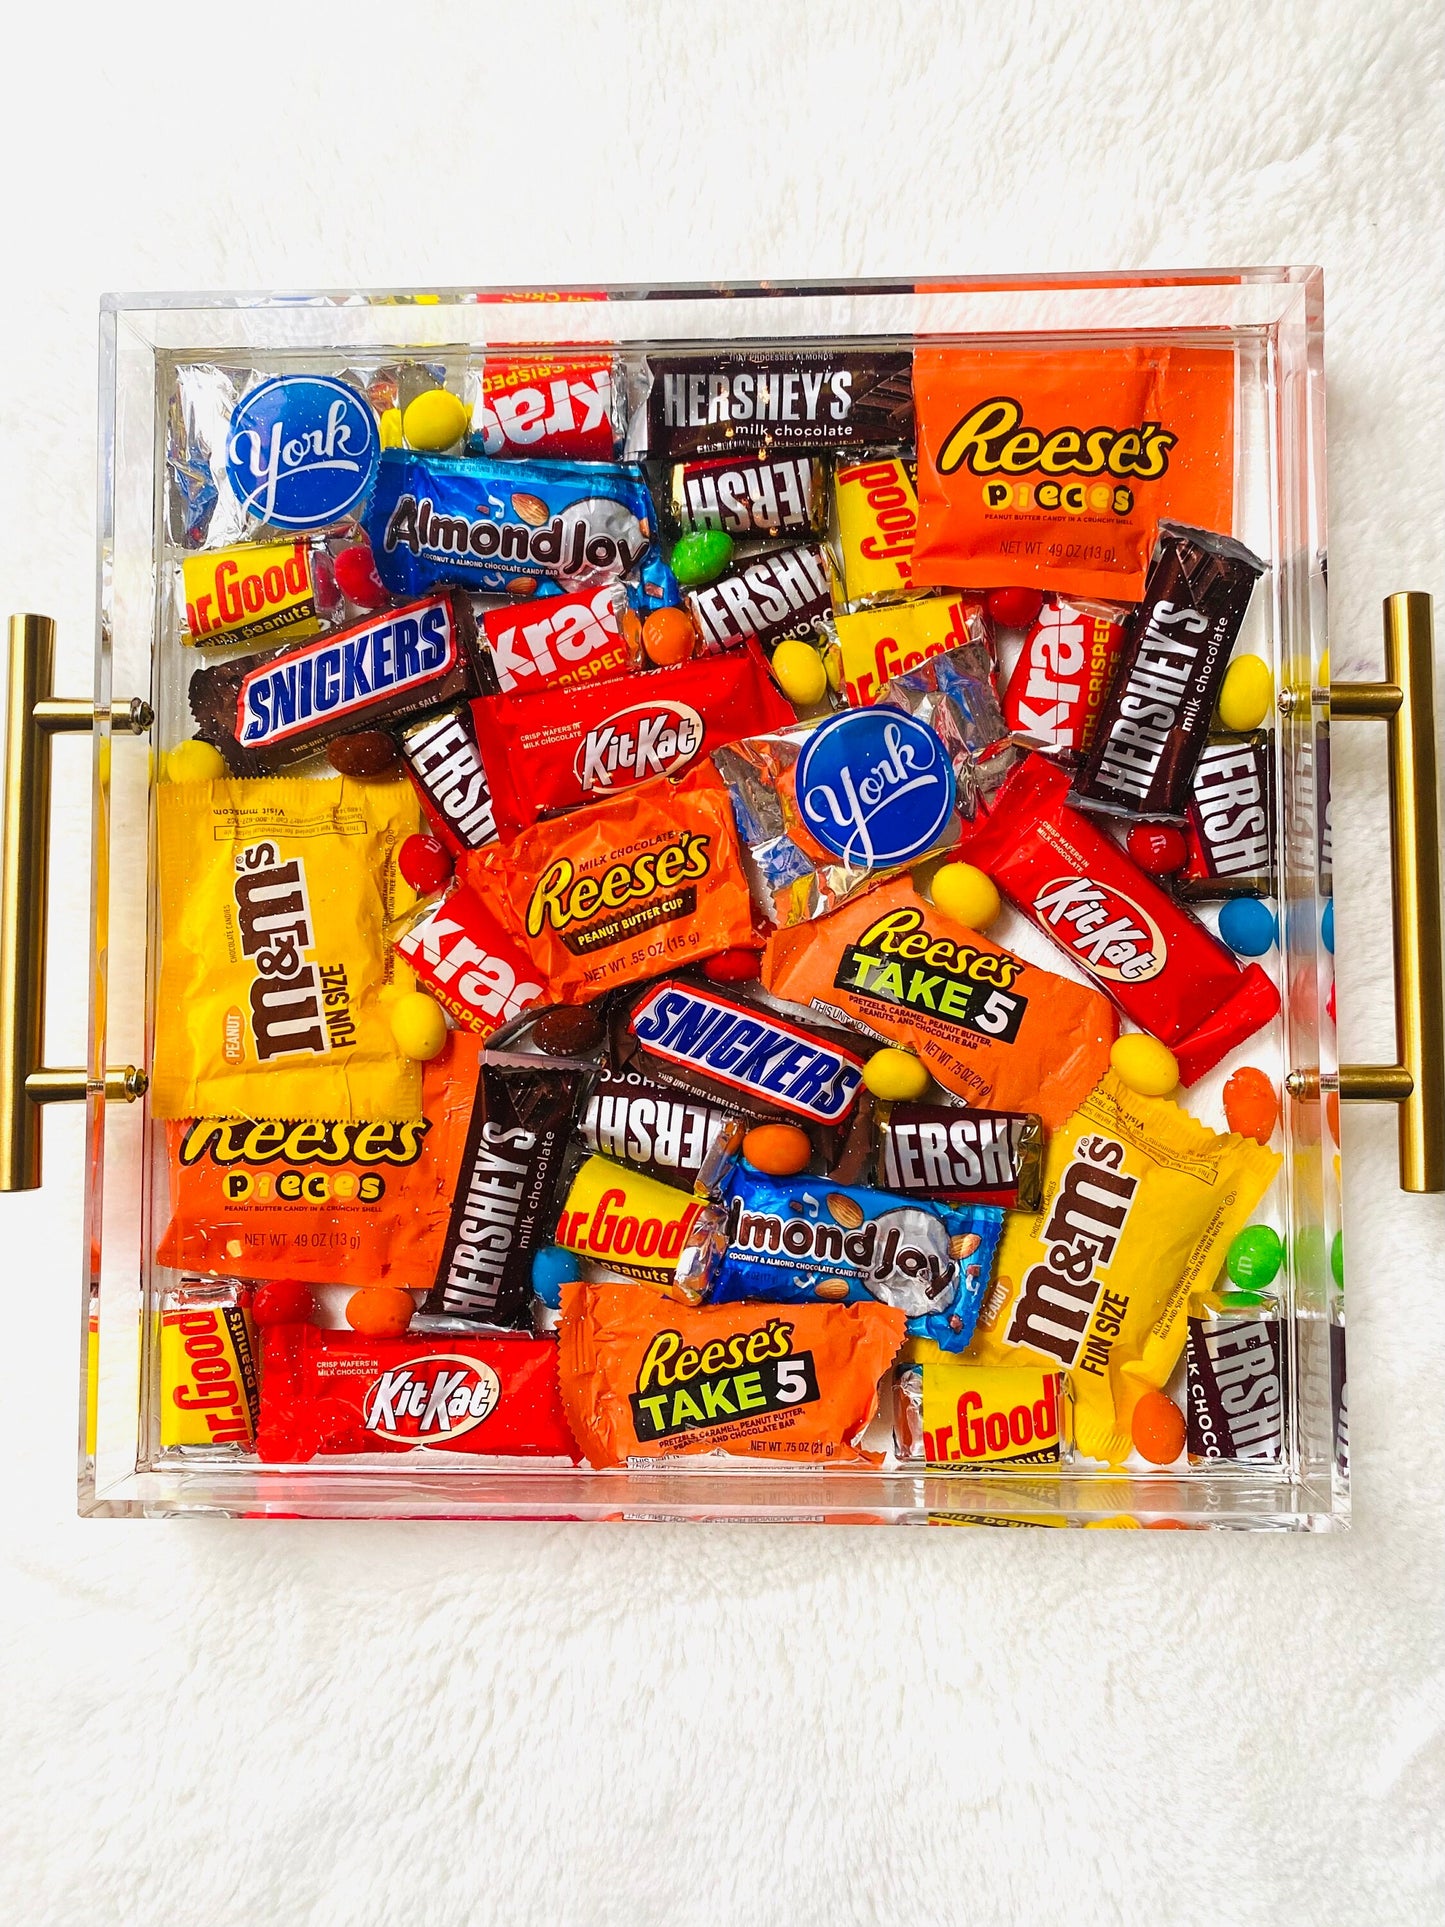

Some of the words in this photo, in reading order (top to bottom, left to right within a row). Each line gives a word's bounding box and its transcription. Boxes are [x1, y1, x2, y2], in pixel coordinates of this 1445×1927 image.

[663, 371, 852, 427] HERSHEY'S
[735, 424, 768, 436] milk
[775, 424, 853, 437] chocolate
[938, 397, 1178, 480] Reese's
[229, 399, 360, 525] York
[385, 495, 563, 564] Almond
[564, 519, 649, 577] Joy
[985, 513, 1012, 521] PEANUT
[1084, 516, 1115, 524] CRUNCHY
[422, 553, 449, 564] COCONUT
[456, 558, 483, 568] ALMOND
[484, 561, 521, 573] CHOCOLATE
[522, 566, 544, 575] CANDY
[1000, 541, 1023, 554] NET
[1025, 542, 1043, 555] WT
[1066, 544, 1081, 558] OZ
[1084, 545, 1102, 561] (13
[242, 605, 310, 638] peanuts
[243, 607, 448, 741] SNICKERS
[1181, 698, 1202, 732] milk
[1196, 616, 1229, 694] chocolate
[418, 697, 439, 709] SALE
[1095, 600, 1209, 799] HERSHEY'S
[520, 731, 541, 743] CRISP
[542, 724, 571, 737] WAFERS
[523, 740, 540, 750] MILK
[541, 731, 582, 746] CHOCOLATE
[581, 713, 699, 791] KitKat
[804, 722, 938, 872] York
[579, 856, 606, 873] MILK
[609, 830, 674, 861] CHOCOLATE
[1036, 827, 1051, 843] MILK
[1049, 839, 1084, 874] CHOCOLATE
[1042, 820, 1060, 841] CRISP
[1058, 835, 1084, 862] WAFERS
[526, 833, 711, 938] Reese's
[577, 923, 620, 946] PEANUT
[622, 907, 660, 928] BUTTER
[662, 898, 684, 914] CUP
[1033, 878, 1157, 980] KitKat
[584, 963, 607, 984] NET
[609, 958, 628, 976] WT
[629, 950, 645, 967] .55
[647, 942, 665, 960] OZ
[666, 935, 687, 956] (15
[860, 907, 1023, 991] Reese's
[319, 963, 350, 1006] SIZE
[851, 952, 974, 1019] TAKE
[974, 990, 1017, 1034] 5
[325, 1008, 357, 1049] FUN
[814, 1001, 833, 1016] THIS
[832, 1009, 852, 1024] UNIT
[849, 995, 886, 1013] PRETZELS,
[889, 1006, 926, 1025] CARAMEL,
[928, 1018, 959, 1034] PEANUT
[859, 1006, 895, 1024] PEANUTS,
[898, 1016, 914, 1027] AND
[915, 1020, 960, 1044] CHOCOLATE
[961, 1037, 978, 1050] BAR
[225, 1014, 241, 1058] PEANUT
[635, 993, 864, 1114] SNICKERS
[923, 1039, 939, 1055] NET
[937, 1049, 951, 1066] WT
[961, 1068, 973, 1082] OZ
[691, 1086, 707, 1097] NOT
[707, 1091, 740, 1110] LABELED
[526, 1130, 556, 1212] chocolate
[326, 1205, 360, 1213] CRUNCHY
[443, 1121, 536, 1312] HERSHEY'S
[245, 1233, 266, 1246] NET
[270, 1234, 288, 1246] WT
[311, 1233, 327, 1247] OZ
[329, 1233, 348, 1248] (13
[350, 1235, 361, 1249] g)
[517, 1214, 536, 1249] milk
[1189, 1233, 1209, 1266] CONTAINS
[729, 1252, 760, 1263] COCONUT
[766, 1258, 795, 1268] ALMOND
[796, 1262, 834, 1274] CHOCOLATE
[835, 1268, 857, 1277] CANDY
[873, 1228, 956, 1300] Joy
[982, 1283, 1010, 1327] PEANUT
[1159, 1322, 1172, 1340] MILK
[1167, 1309, 1179, 1324] AND
[1182, 1281, 1193, 1296] MAY
[1203, 1237, 1215, 1254] TREE
[1094, 1289, 1130, 1337] SIZE
[230, 1312, 256, 1389] peanuts
[316, 1360, 338, 1368] CRISP
[339, 1359, 369, 1368] WAFERS
[318, 1368, 335, 1377] MILK
[336, 1368, 379, 1377] CHOCOLATE
[639, 1318, 795, 1393] Reese's
[1079, 1331, 1113, 1377] FUN
[365, 1370, 490, 1431] KitKat
[638, 1371, 767, 1433] TAKE
[775, 1360, 808, 1403] 5
[699, 1424, 739, 1439] CARAMEL,
[740, 1416, 772, 1429] PEANUT
[711, 1433, 729, 1444] AND
[730, 1425, 778, 1440] CHOCOLATE
[779, 1418, 795, 1430] BAR
[751, 1441, 767, 1452] NET
[769, 1441, 782, 1453] WT
[783, 1442, 797, 1454] .75
[798, 1442, 810, 1453] OZ
[811, 1442, 824, 1456] (21
